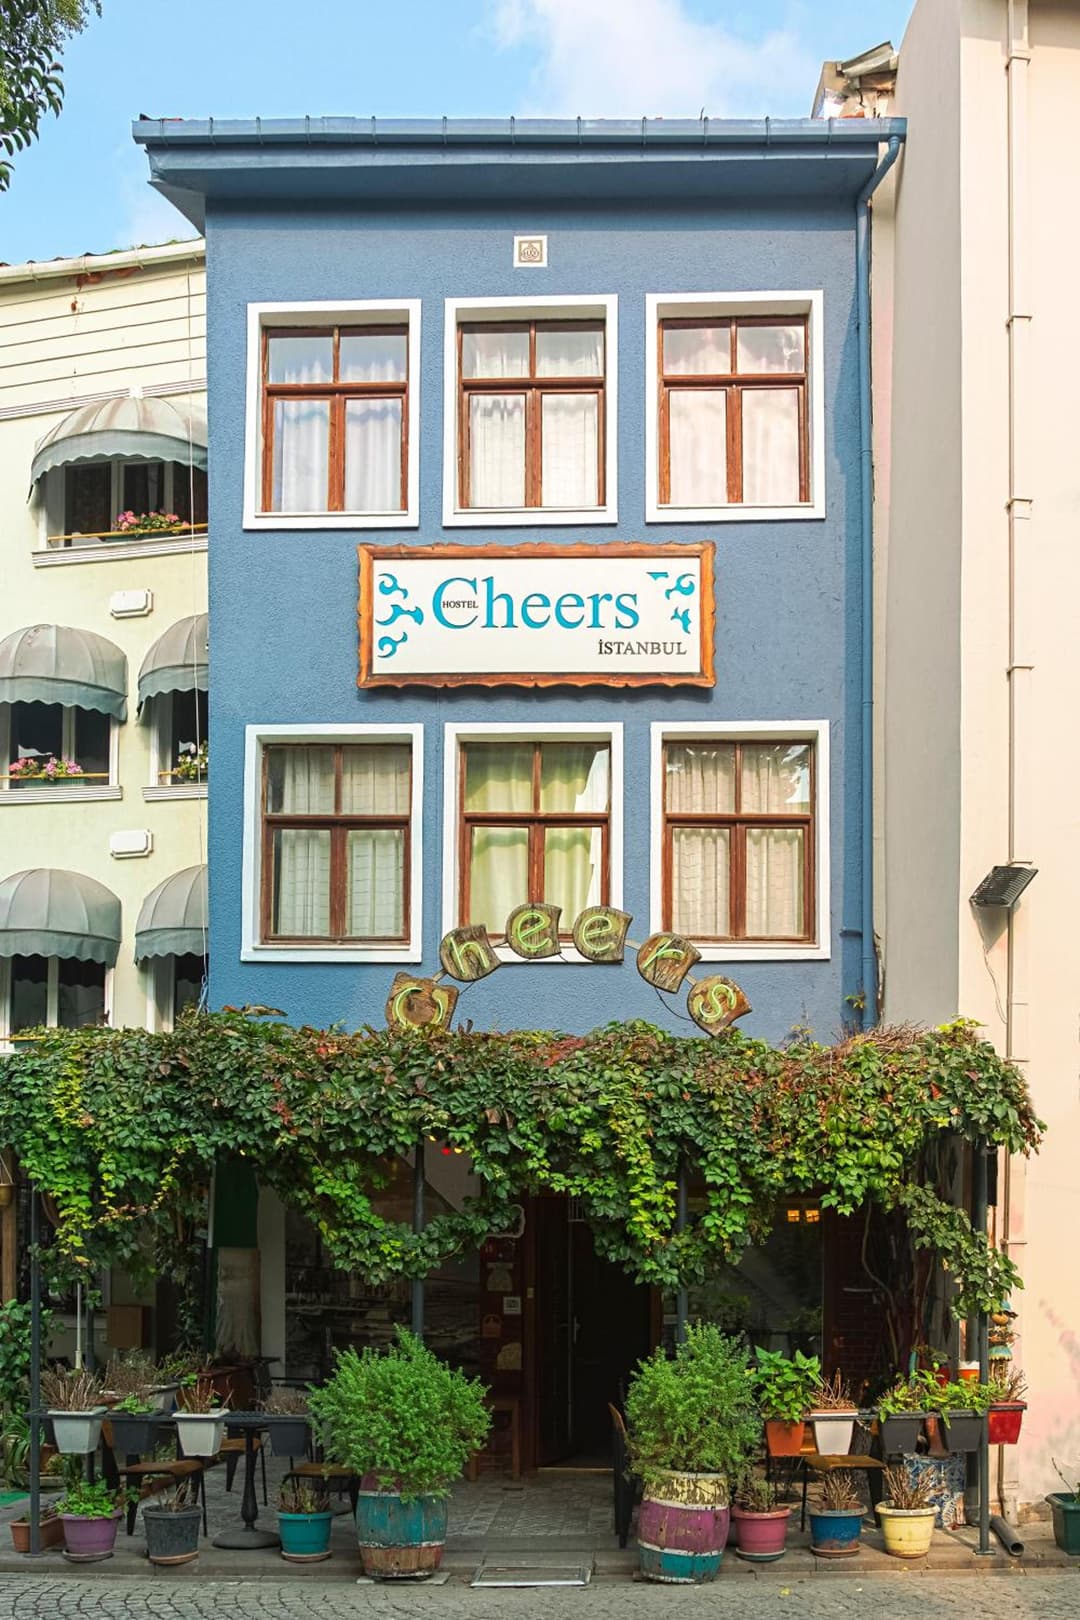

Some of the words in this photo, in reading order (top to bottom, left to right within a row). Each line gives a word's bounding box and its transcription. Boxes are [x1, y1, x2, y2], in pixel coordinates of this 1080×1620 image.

[432, 576, 640, 629] Cheers
[442, 600, 479, 609] HOSTEL
[598, 639, 688, 655] İSTANBUL
[391, 910, 739, 1030] Cheers
